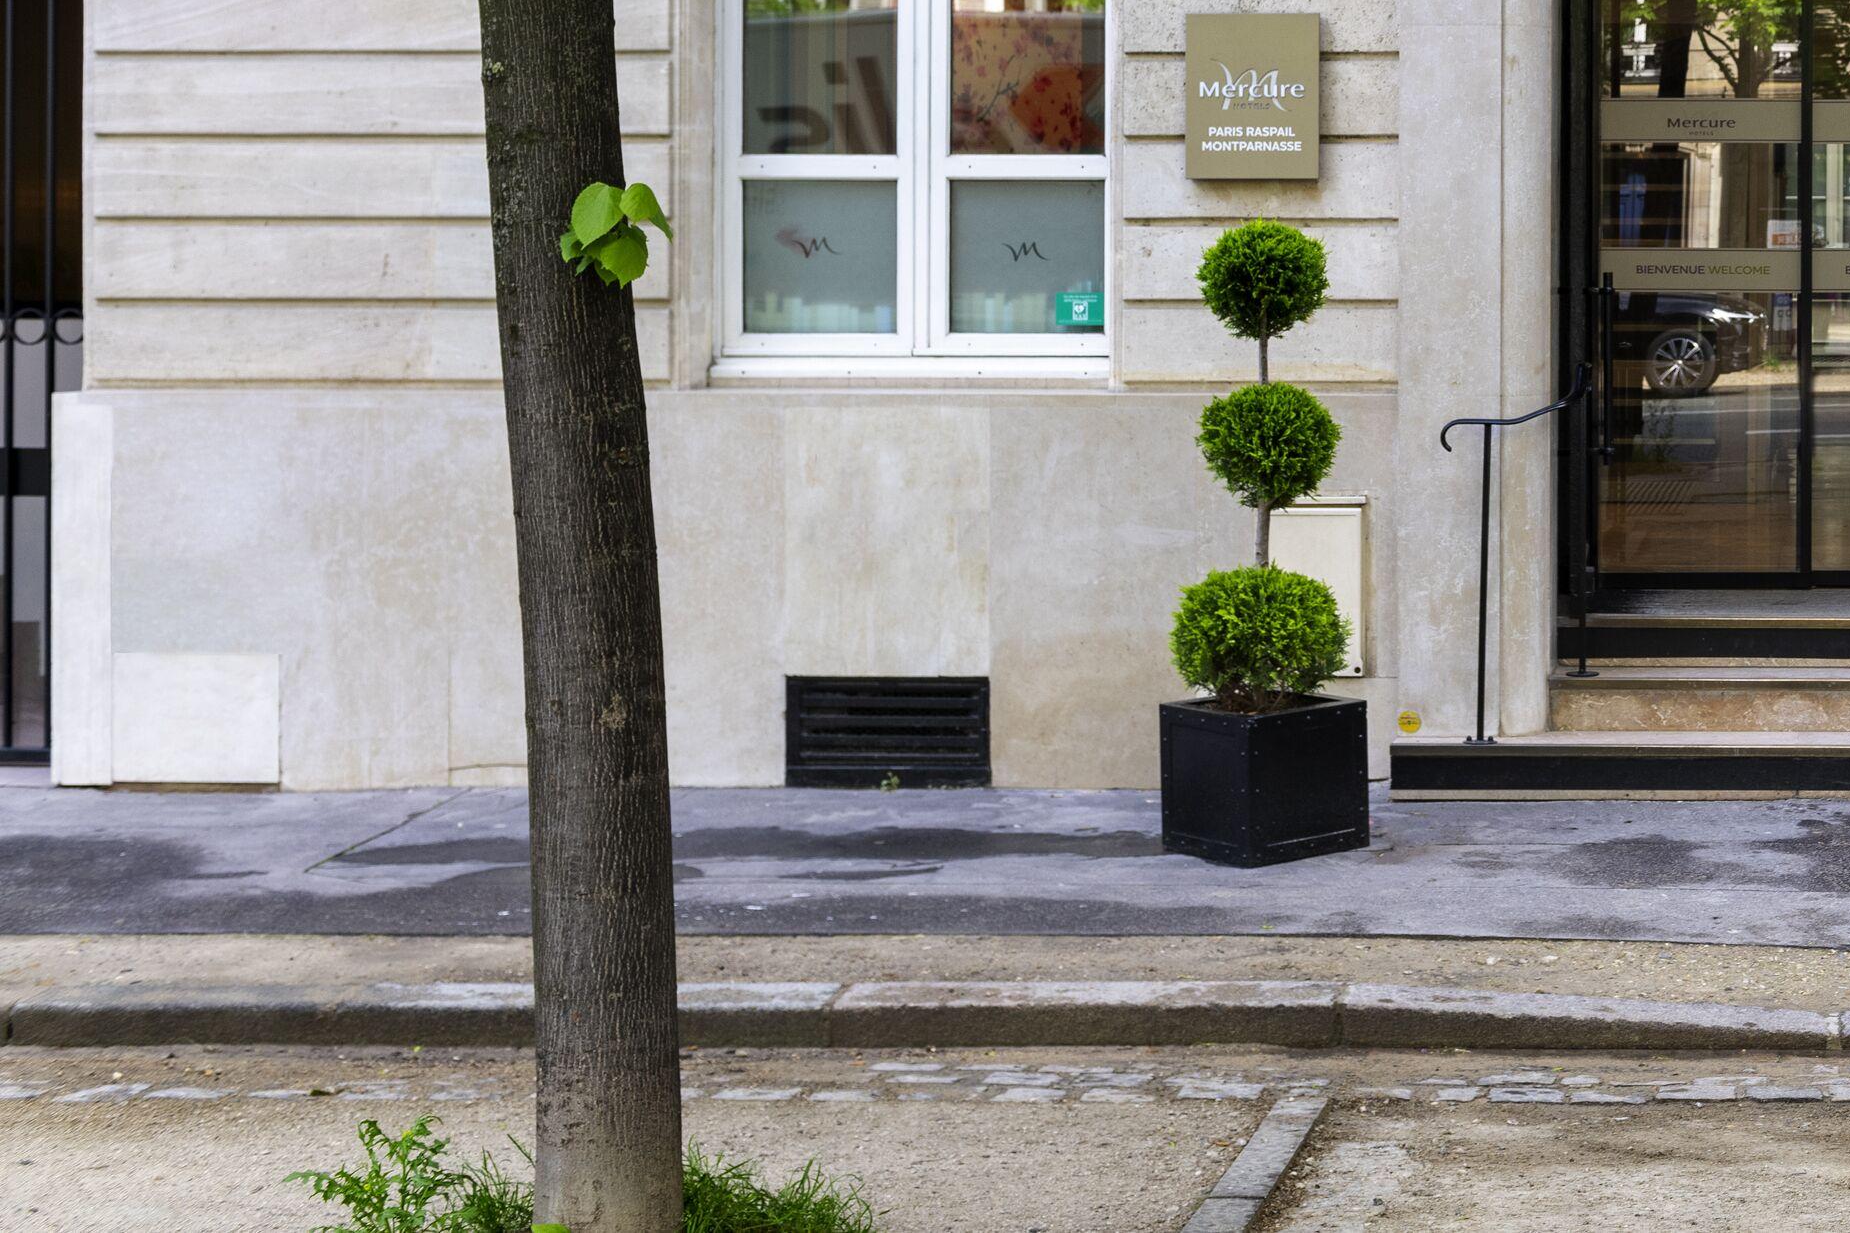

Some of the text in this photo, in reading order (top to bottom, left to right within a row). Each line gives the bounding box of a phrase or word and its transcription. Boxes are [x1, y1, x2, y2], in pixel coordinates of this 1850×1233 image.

[1199, 81, 1305, 99] Mercure
[1666, 117, 1737, 129] Mercure
[1208, 126, 1296, 137] PARIS RASPAIL
[1201, 141, 1302, 151] MONTPARNASSE
[1635, 264, 1771, 276] BIENVENUE WELCOME
